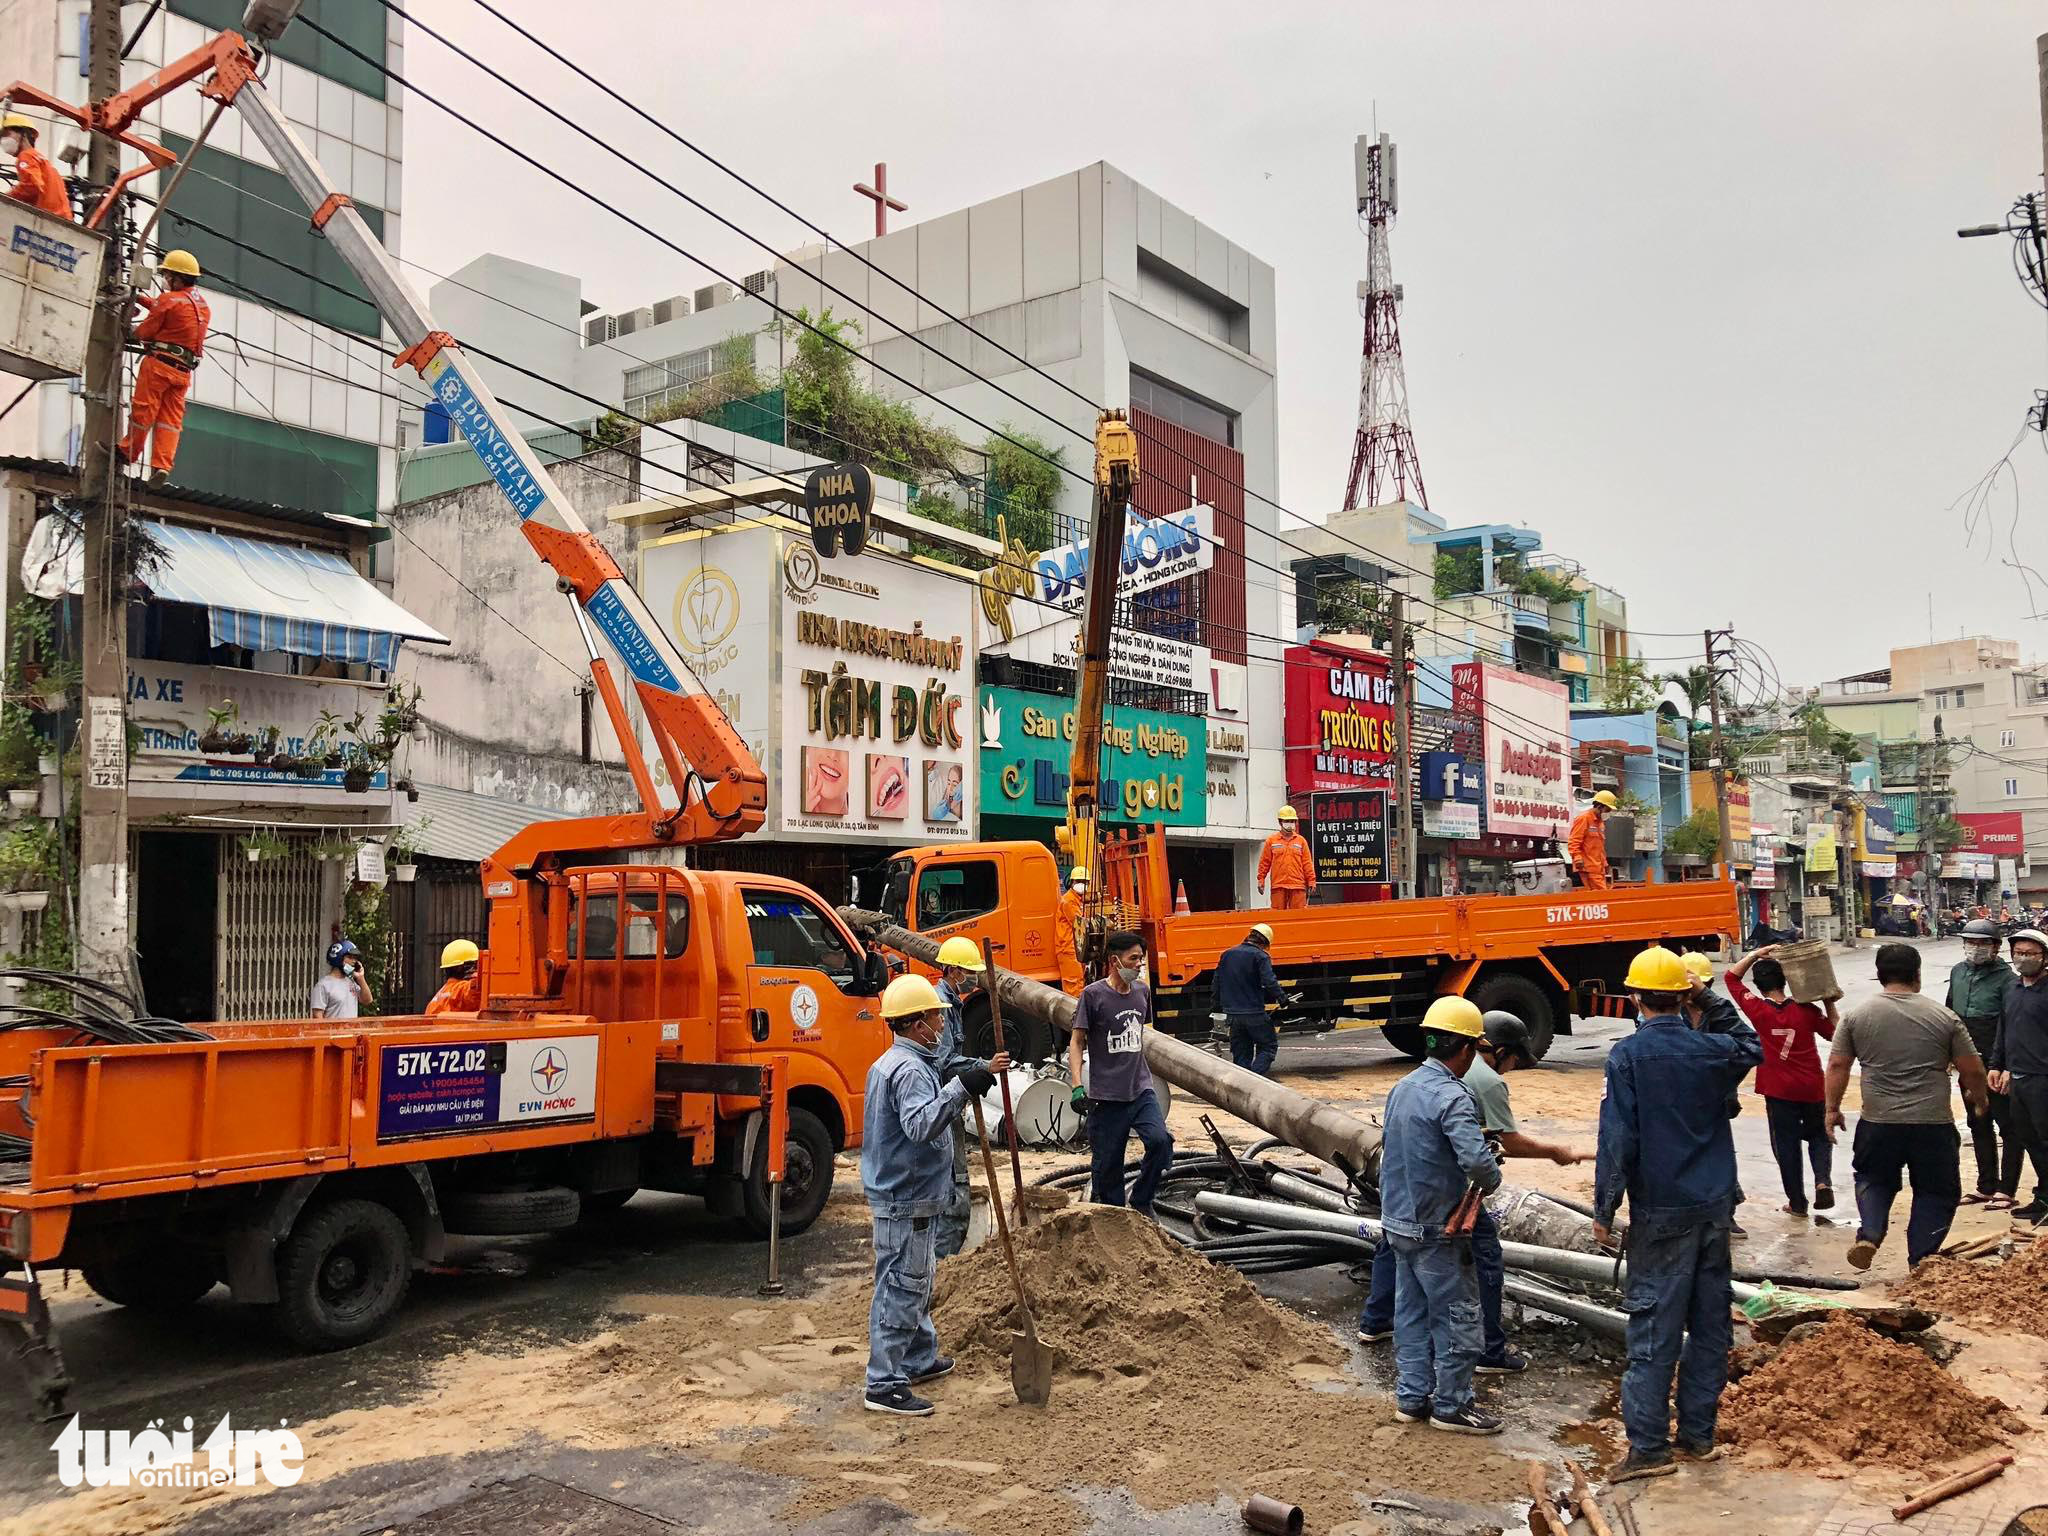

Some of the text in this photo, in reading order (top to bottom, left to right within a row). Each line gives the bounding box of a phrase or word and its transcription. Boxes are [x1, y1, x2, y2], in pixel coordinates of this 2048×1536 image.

[452, 409, 528, 513] 82 41 841 1116
[461, 398, 540, 503] DONGHAE
[819, 473, 855, 498] NHA
[814, 502, 861, 528] KHOA
[820, 573, 880, 596] DENTAL CLINIC
[1116, 581, 1138, 595] REA
[599, 588, 618, 611] DH
[615, 608, 657, 666] WONDER
[652, 665, 669, 682] 21
[797, 610, 840, 648] NHA
[840, 620, 892, 660] KHOA
[1053, 653, 1070, 666] DỊCH
[1152, 658, 1156, 667] &
[1117, 664, 1131, 677] NHÀ
[1132, 668, 1153, 680] NHANH
[1330, 659, 1370, 701] CẦM
[156, 679, 184, 703] XE
[801, 660, 881, 742] TÂM
[891, 677, 963, 749] ĐỨC
[1023, 706, 1057, 739] Sàn
[1137, 724, 1188, 762] Nghiệp
[1321, 701, 1379, 752] TRƯỜNG
[1213, 727, 1245, 753] LÀNH
[263, 772, 284, 780] LONG
[1124, 772, 1183, 818] gold
[1316, 797, 1353, 820] CẦM
[1354, 822, 1359, 830] 3
[1361, 820, 1381, 831] TRIỆU
[1330, 833, 1339, 843] TÔ
[1346, 834, 1355, 843] XE
[1357, 833, 1375, 842] MÁY
[1349, 843, 1365, 854] GÓP
[1983, 833, 2017, 842] PRIME
[1339, 869, 1352, 877] SIM
[1546, 904, 1609, 923] 57K-7095
[1771, 1029, 1796, 1061] 7
[397, 1048, 486, 1076] 57K-72.02
[399, 1103, 412, 1115] GIẢI
[413, 1102, 425, 1113] ĐÁP
[437, 1102, 449, 1110] NHU
[519, 1097, 576, 1113] EVN HCMC
